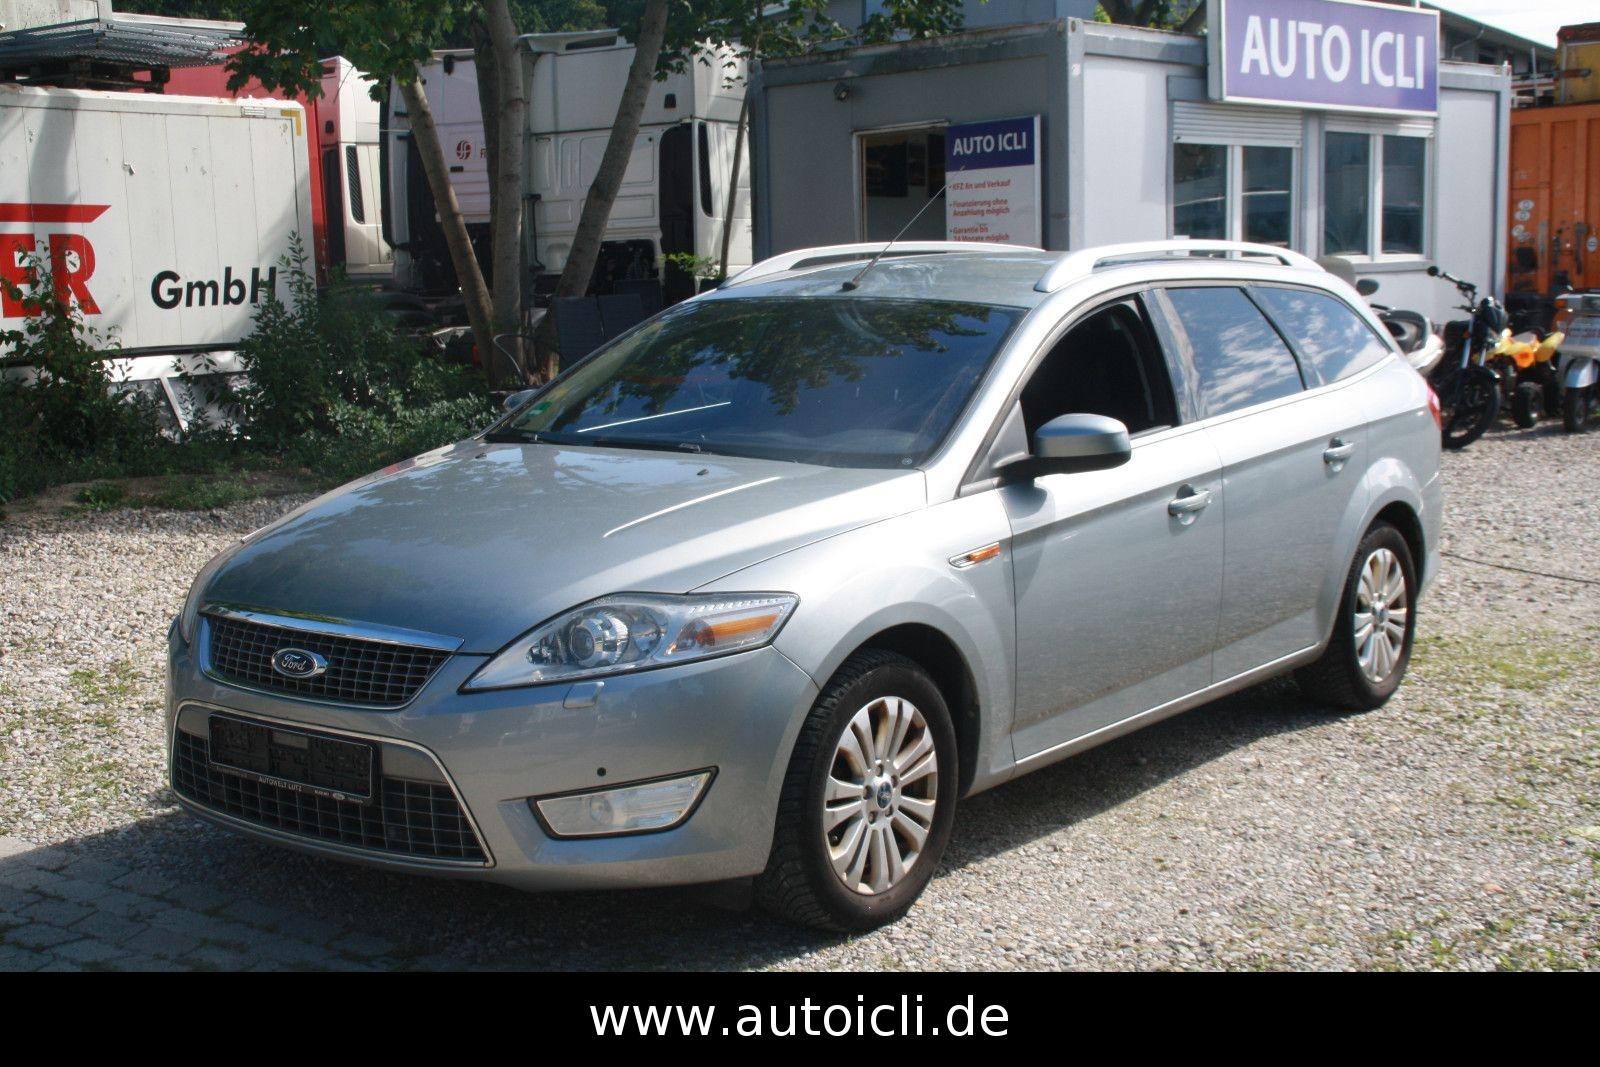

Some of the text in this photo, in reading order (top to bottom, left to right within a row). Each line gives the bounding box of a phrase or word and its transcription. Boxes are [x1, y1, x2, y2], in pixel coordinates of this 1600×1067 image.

[1240, 15, 1425, 90] AUTO ICLI
[953, 131, 1027, 156] AUTO ICLI
[952, 182, 964, 190] KFZ
[975, 181, 987, 189] und
[987, 179, 1011, 188] Verkauf
[953, 198, 1008, 208] Finanzierung ohne
[952, 207, 1010, 217] Anzahlung möglich
[952, 224, 989, 234] Garantie bis
[985, 233, 1009, 243] möglich
[151, 266, 277, 310] GmbH
[281, 653, 307, 671] Ford
